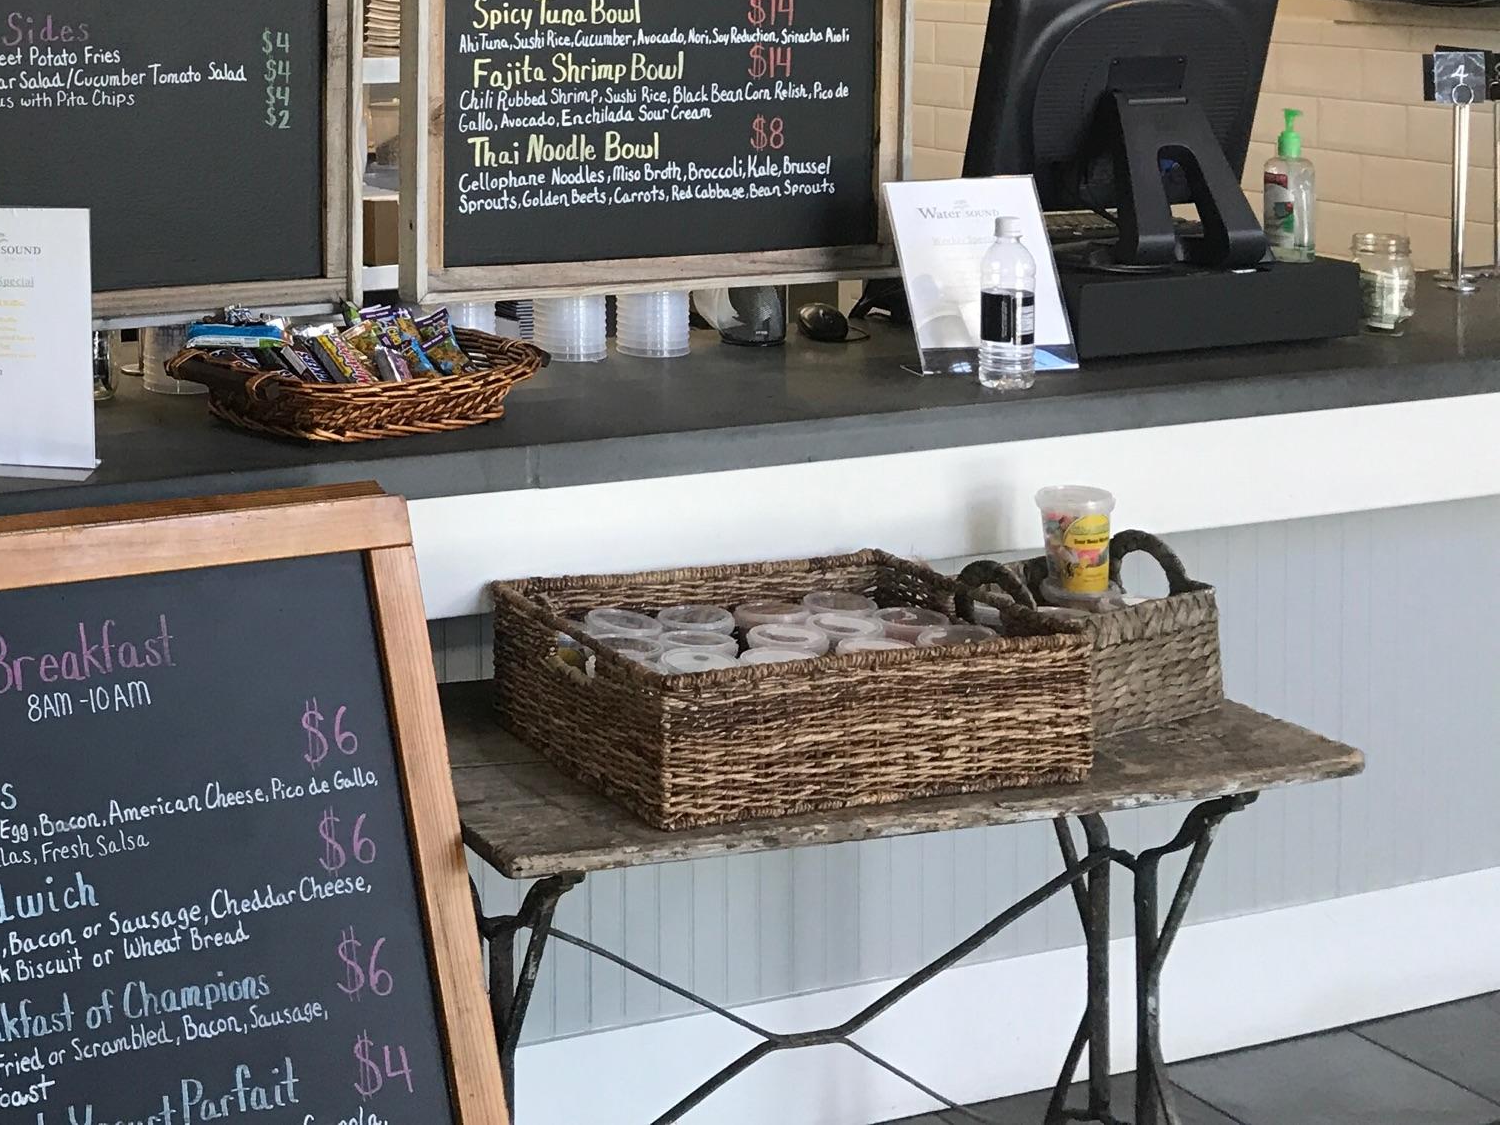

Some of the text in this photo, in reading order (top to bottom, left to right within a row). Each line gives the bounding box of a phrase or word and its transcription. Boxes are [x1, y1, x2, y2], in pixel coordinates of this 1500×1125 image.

[2, 11, 90, 46] Sides
[472, 50, 686, 89] Fajita Shrimp Bowl
[748, 43, 792, 81] $14
[1450, 64, 1469, 85] 4
[264, 108, 291, 129] $2
[458, 103, 712, 133] Gallo, Avocado, Enchilada Sour Cream
[749, 113, 785, 151] $8
[467, 131, 660, 169] Thai Noodle Bowl
[26, 691, 74, 722] 8AM
[300, 697, 359, 770] $6
[41, 839, 94, 863] Fresh
[97, 831, 150, 853] Salsa
[318, 806, 377, 878] $6
[15, 950, 83, 983] Biscuit
[92, 948, 115, 968] or
[122, 935, 182, 962] Wheat
[190, 925, 250, 953] Bread
[336, 926, 394, 1002] $6
[85, 988, 115, 1030] of
[122, 971, 272, 1020] Champions
[353, 1029, 414, 1101] $4
[179, 1056, 301, 1123] Parfait
